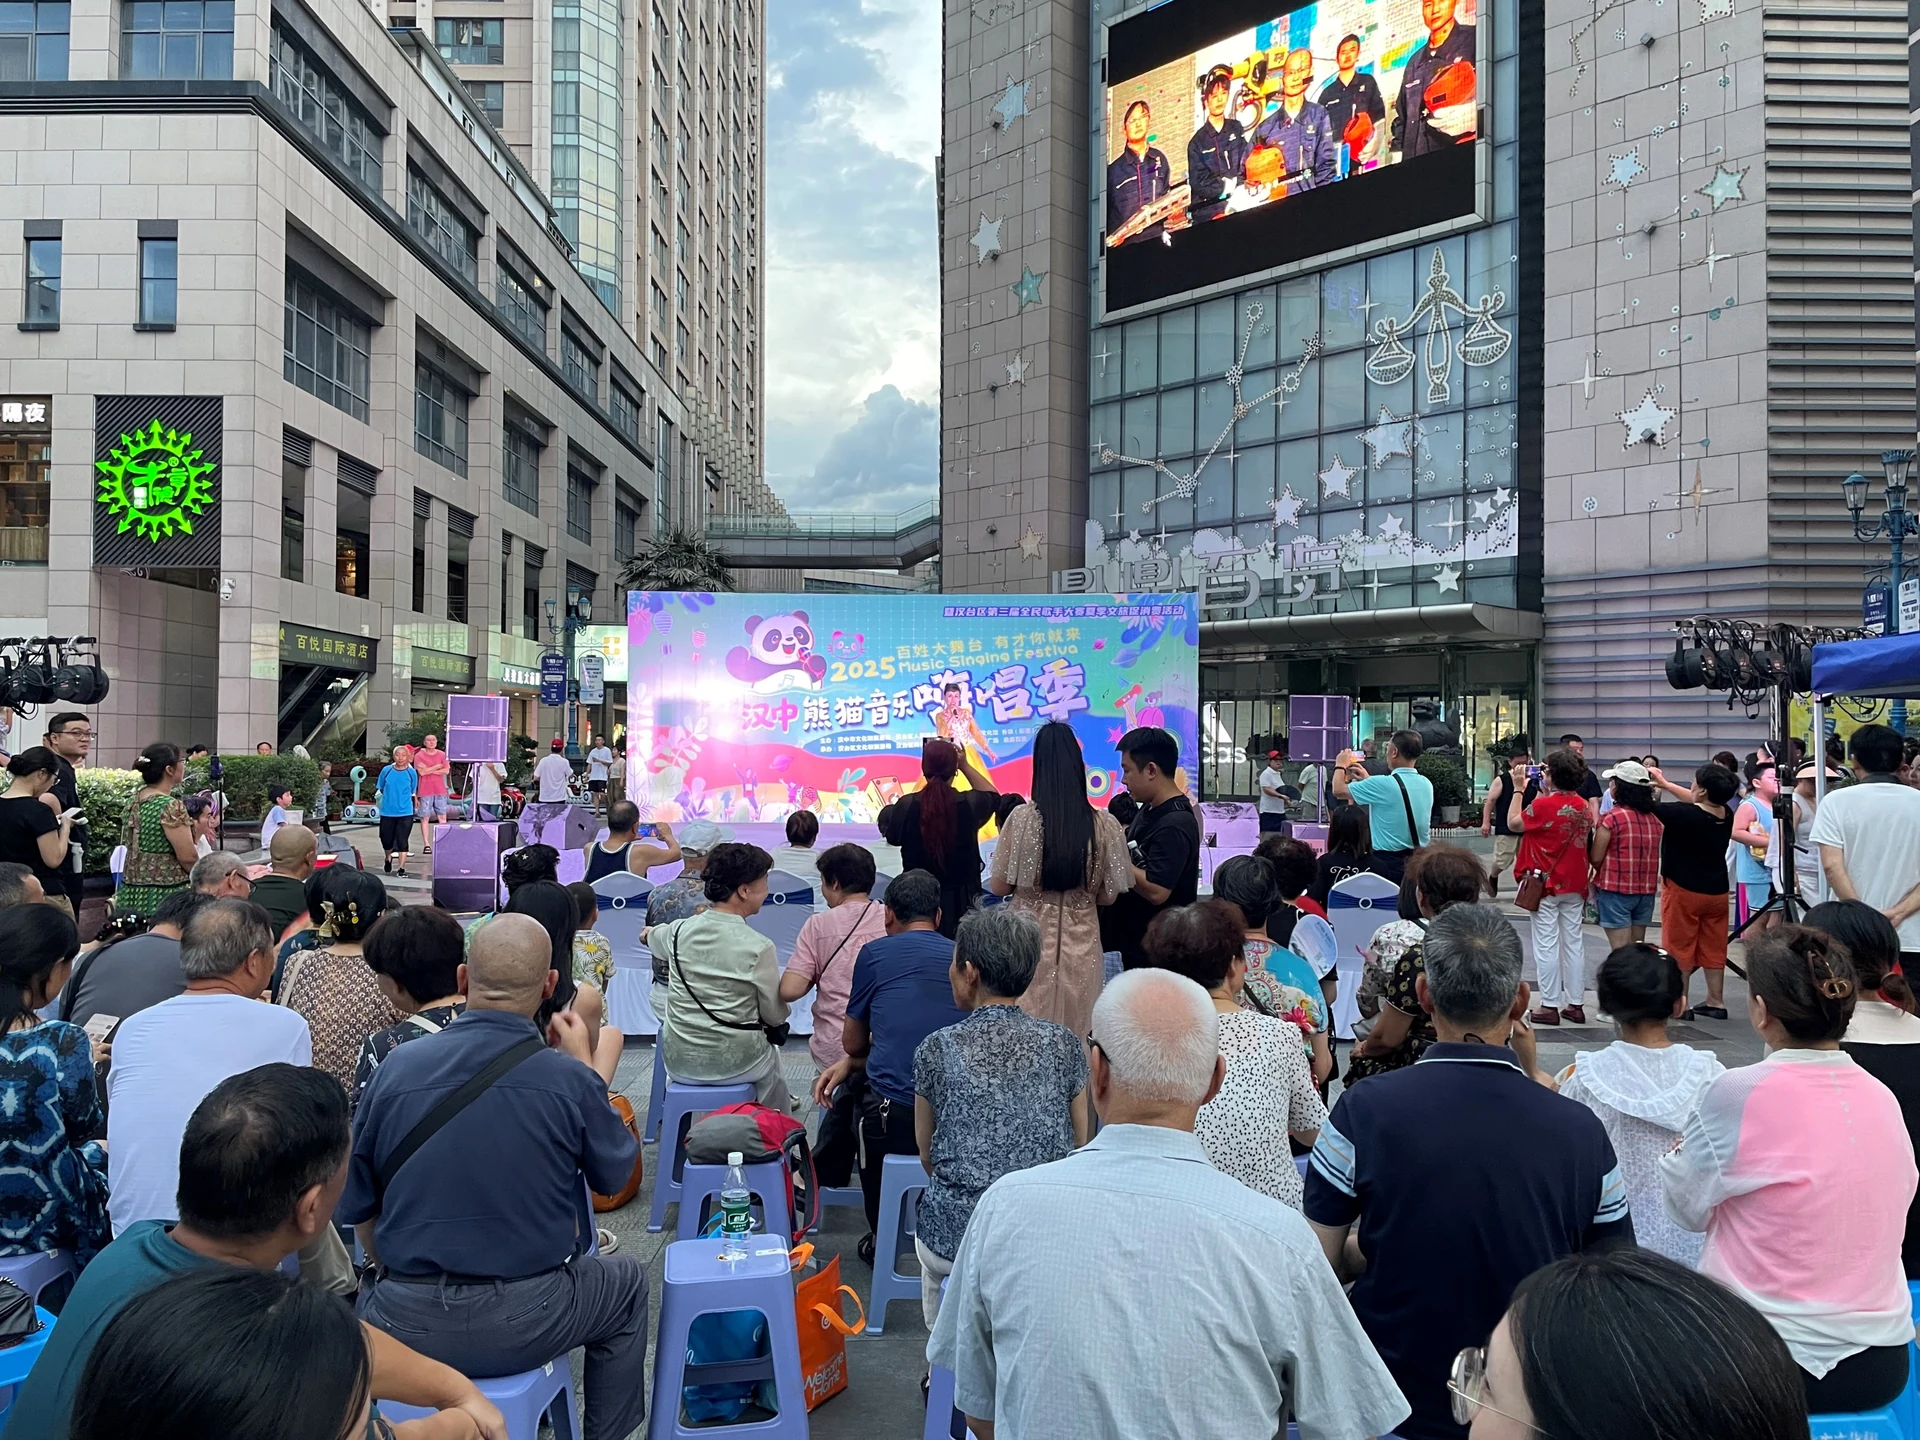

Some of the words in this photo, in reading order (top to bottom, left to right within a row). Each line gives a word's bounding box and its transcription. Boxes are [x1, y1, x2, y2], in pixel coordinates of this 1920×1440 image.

[296, 634, 368, 659] 百悦国际酒店
[830, 655, 896, 682] 2025
[898, 658, 945, 674] Music
